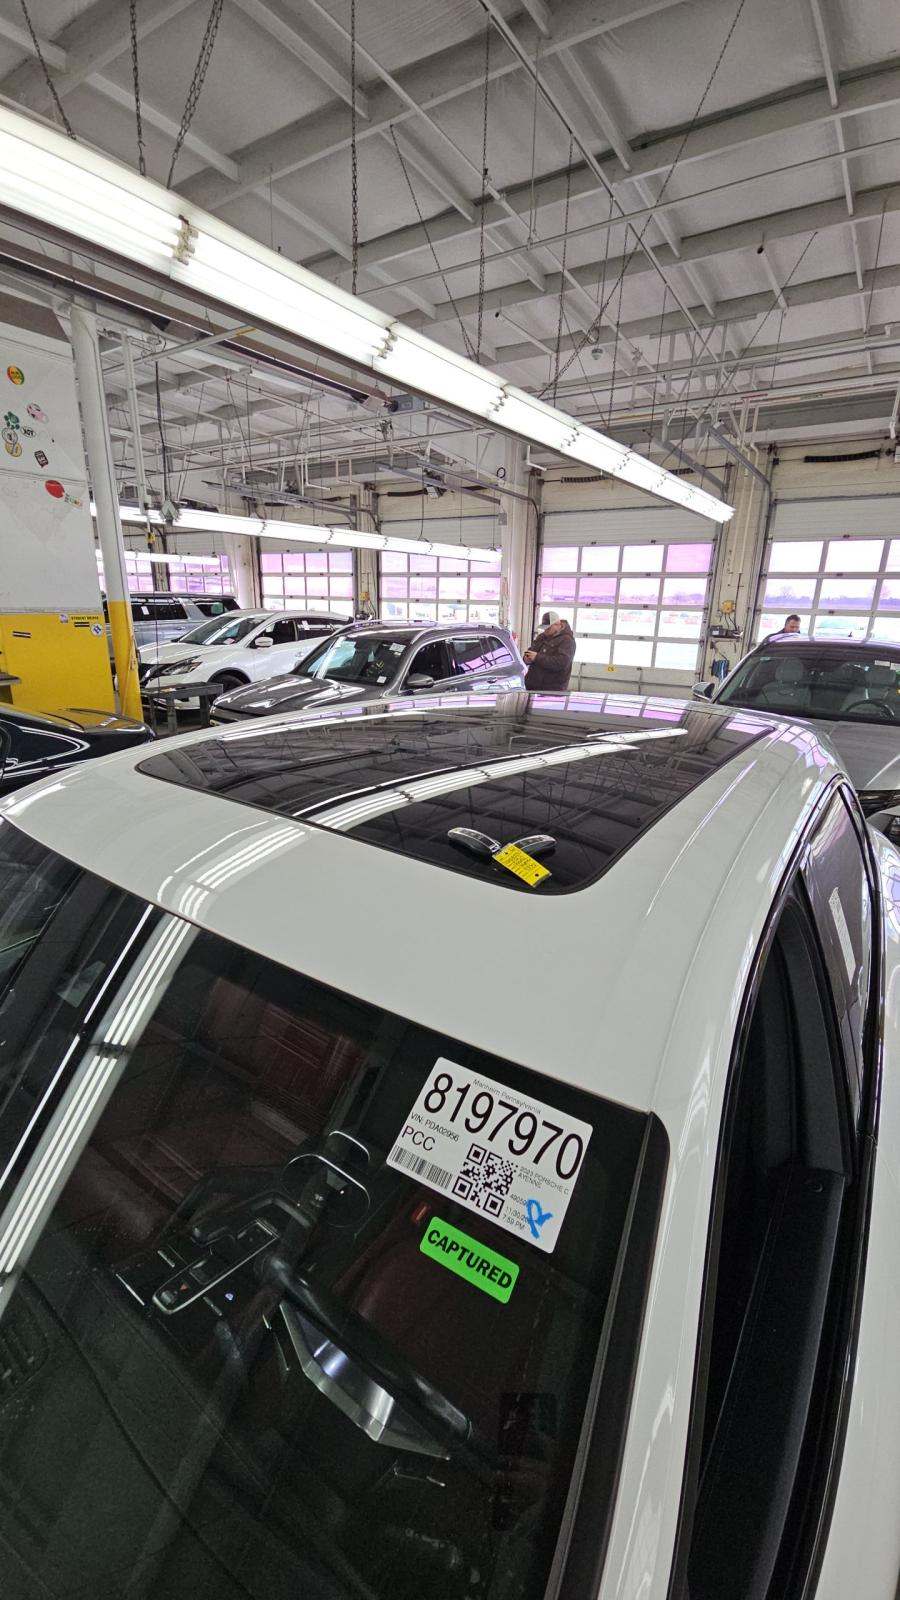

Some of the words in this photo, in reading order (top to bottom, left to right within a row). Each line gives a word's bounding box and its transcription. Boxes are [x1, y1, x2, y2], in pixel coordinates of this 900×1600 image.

[401, 1125, 436, 1151] PCC
[410, 1112, 424, 1126] VIN:
[425, 1119, 460, 1142] PDA02956
[424, 1073, 584, 1180] 8197970
[427, 1228, 513, 1290] CAPTURED
